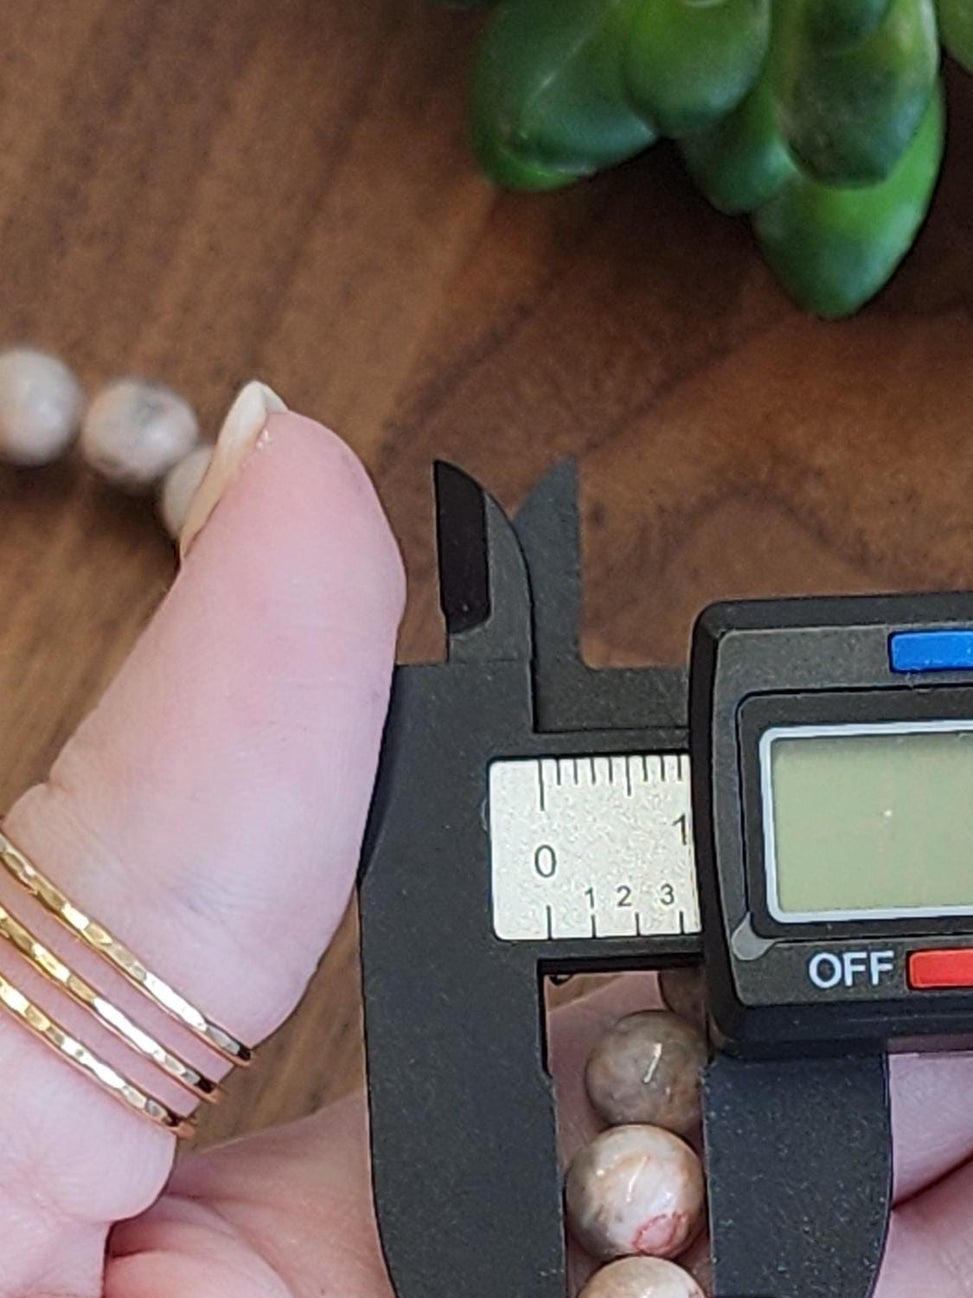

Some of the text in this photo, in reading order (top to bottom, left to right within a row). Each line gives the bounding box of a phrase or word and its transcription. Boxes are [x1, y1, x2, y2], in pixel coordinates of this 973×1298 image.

[534, 844, 556, 878] 0
[584, 883, 675, 909] 1 2 3
[808, 950, 895, 988] OFF
